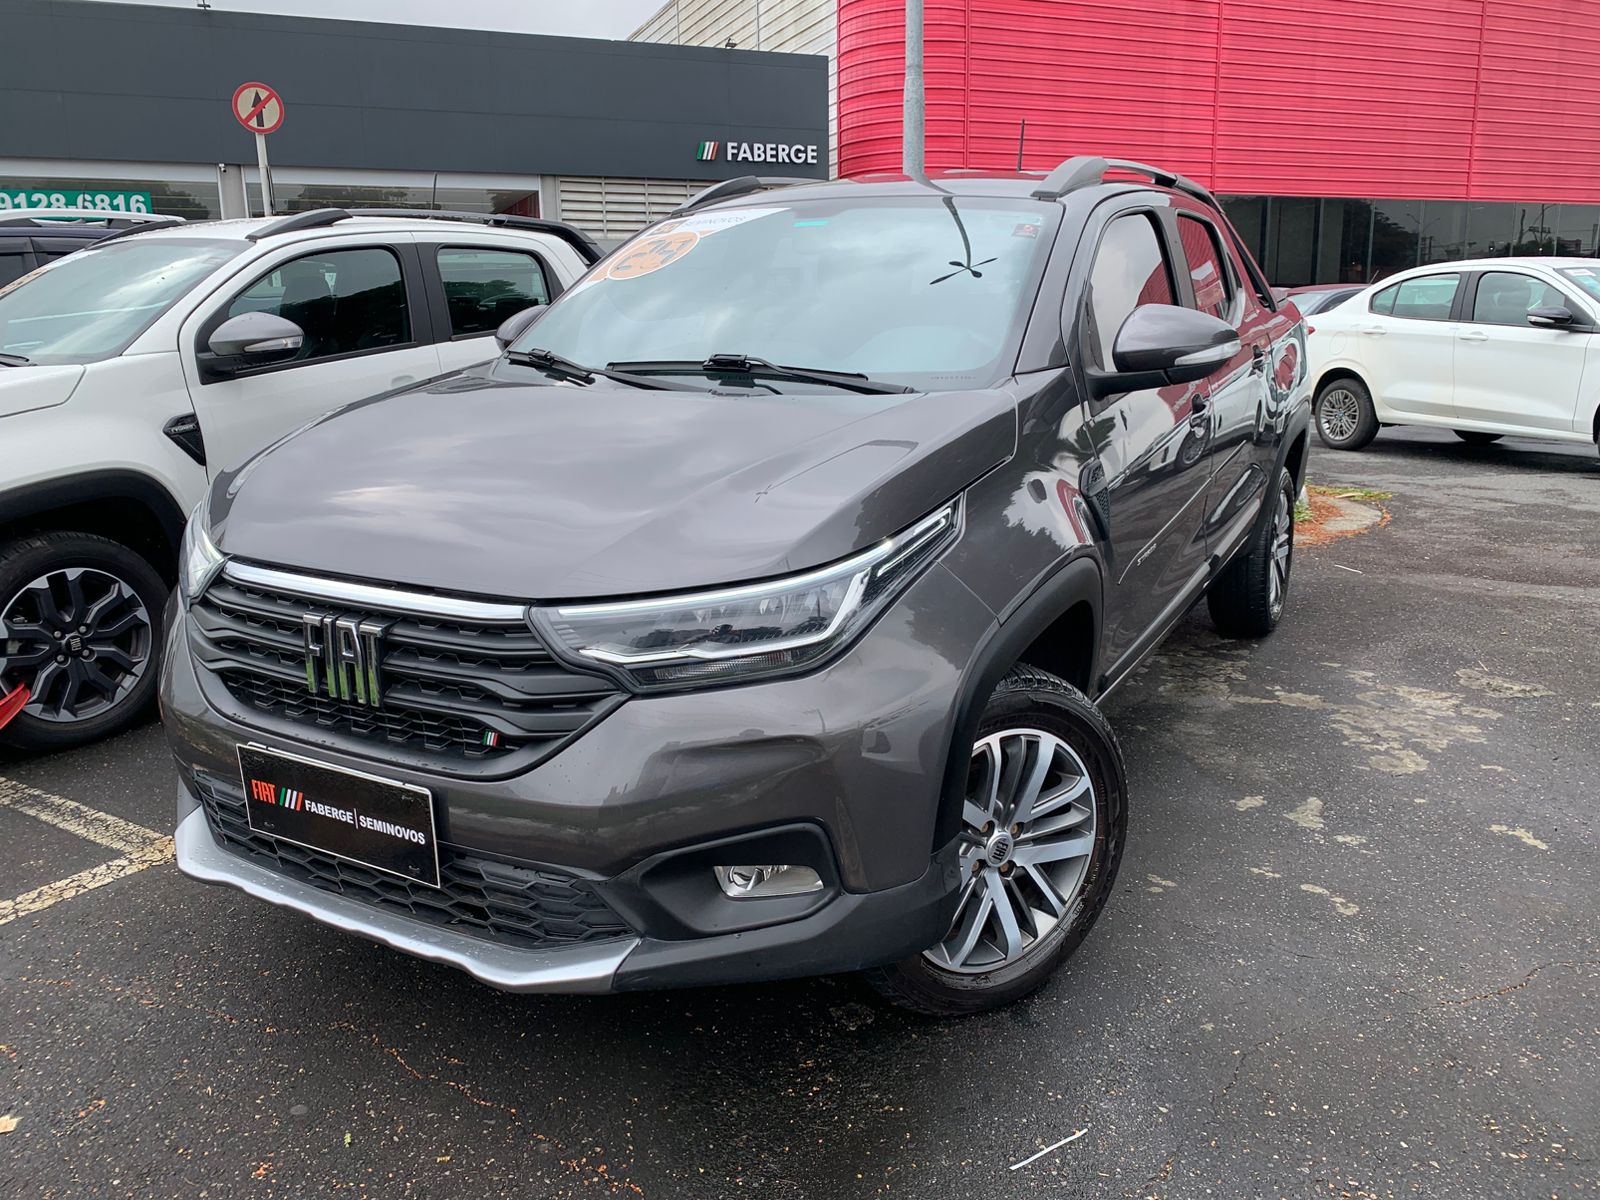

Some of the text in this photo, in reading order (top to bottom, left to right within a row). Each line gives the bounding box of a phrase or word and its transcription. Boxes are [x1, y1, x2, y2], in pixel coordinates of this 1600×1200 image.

[726, 141, 818, 164] FABERGE
[303, 614, 382, 707] FIAT
[251, 779, 426, 845] FIAT FABERGE SEMINOVOS
[991, 841, 1009, 862] FIAT
